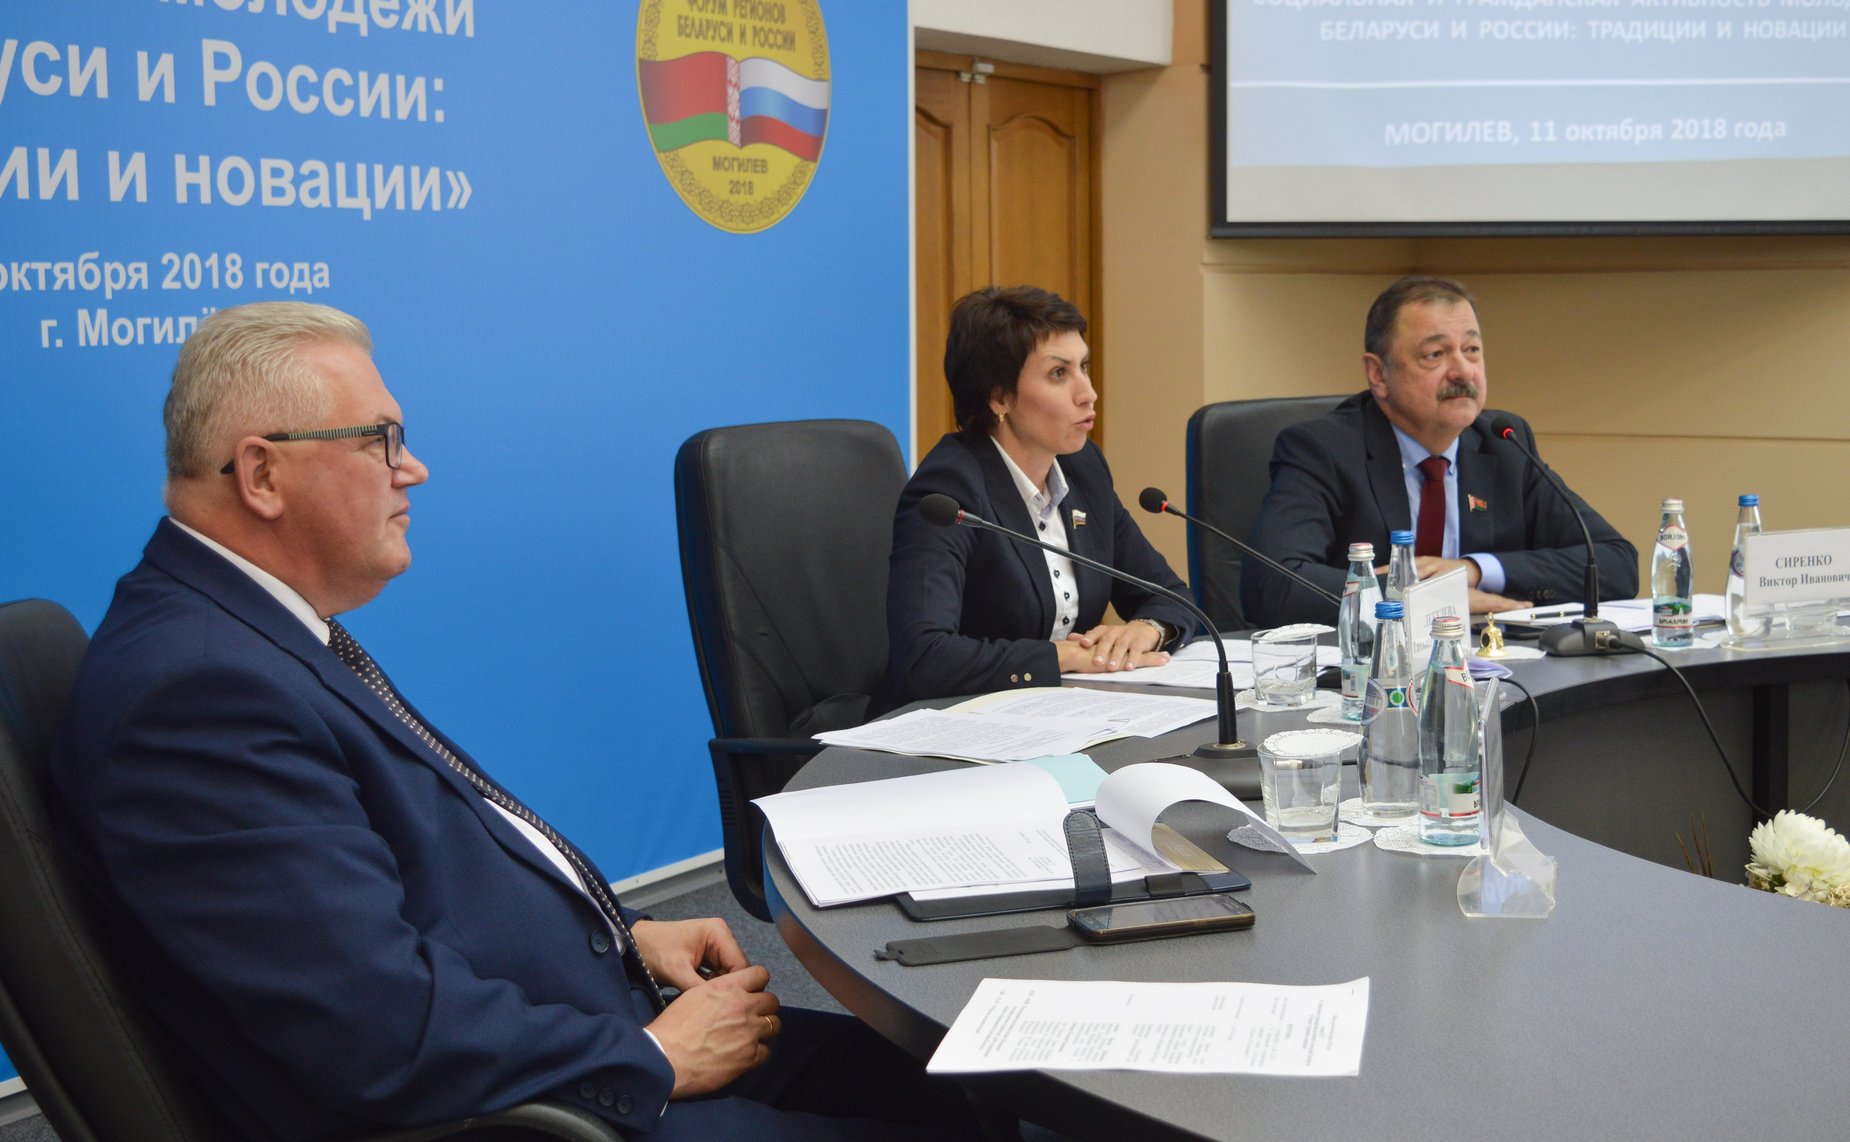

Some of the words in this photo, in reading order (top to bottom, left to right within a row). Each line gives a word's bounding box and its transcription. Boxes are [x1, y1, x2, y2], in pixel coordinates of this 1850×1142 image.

[160, 0, 475, 37] дежи
[1319, 20, 1440, 41] БЕЛАРУСИ
[1450, 20, 1468, 40] И
[1478, 20, 1577, 40] РОССИИ:
[1587, 20, 1707, 43] ТРАДИЦИИ
[1717, 20, 1733, 39] И
[1743, 20, 1847, 42] НОВАЦИИ
[677, 14, 734, 44] БЕЛАРУСИ
[739, 23, 747, 46] И
[752, 25, 796, 52] РОССИИ
[137, 50, 176, 104] и
[201, 38, 445, 123] России:
[1384, 120, 1519, 146] МОГИЛЕВ,
[1529, 120, 1558, 142] 11
[1565, 118, 1663, 145] октября
[1671, 118, 1728, 141] 2018
[1734, 119, 1788, 142] года
[712, 155, 768, 174] МОГИЛЕВ
[108, 150, 148, 203] и
[174, 153, 473, 221] новации»
[729, 180, 754, 196] 2018
[161, 252, 244, 290] 2018
[255, 260, 331, 294] года
[41, 319, 63, 348] г.
[1775, 554, 1832, 569] СИРЕНКО
[1759, 575, 1797, 588] Виктор
[1801, 573, 1850, 585] Иванович
